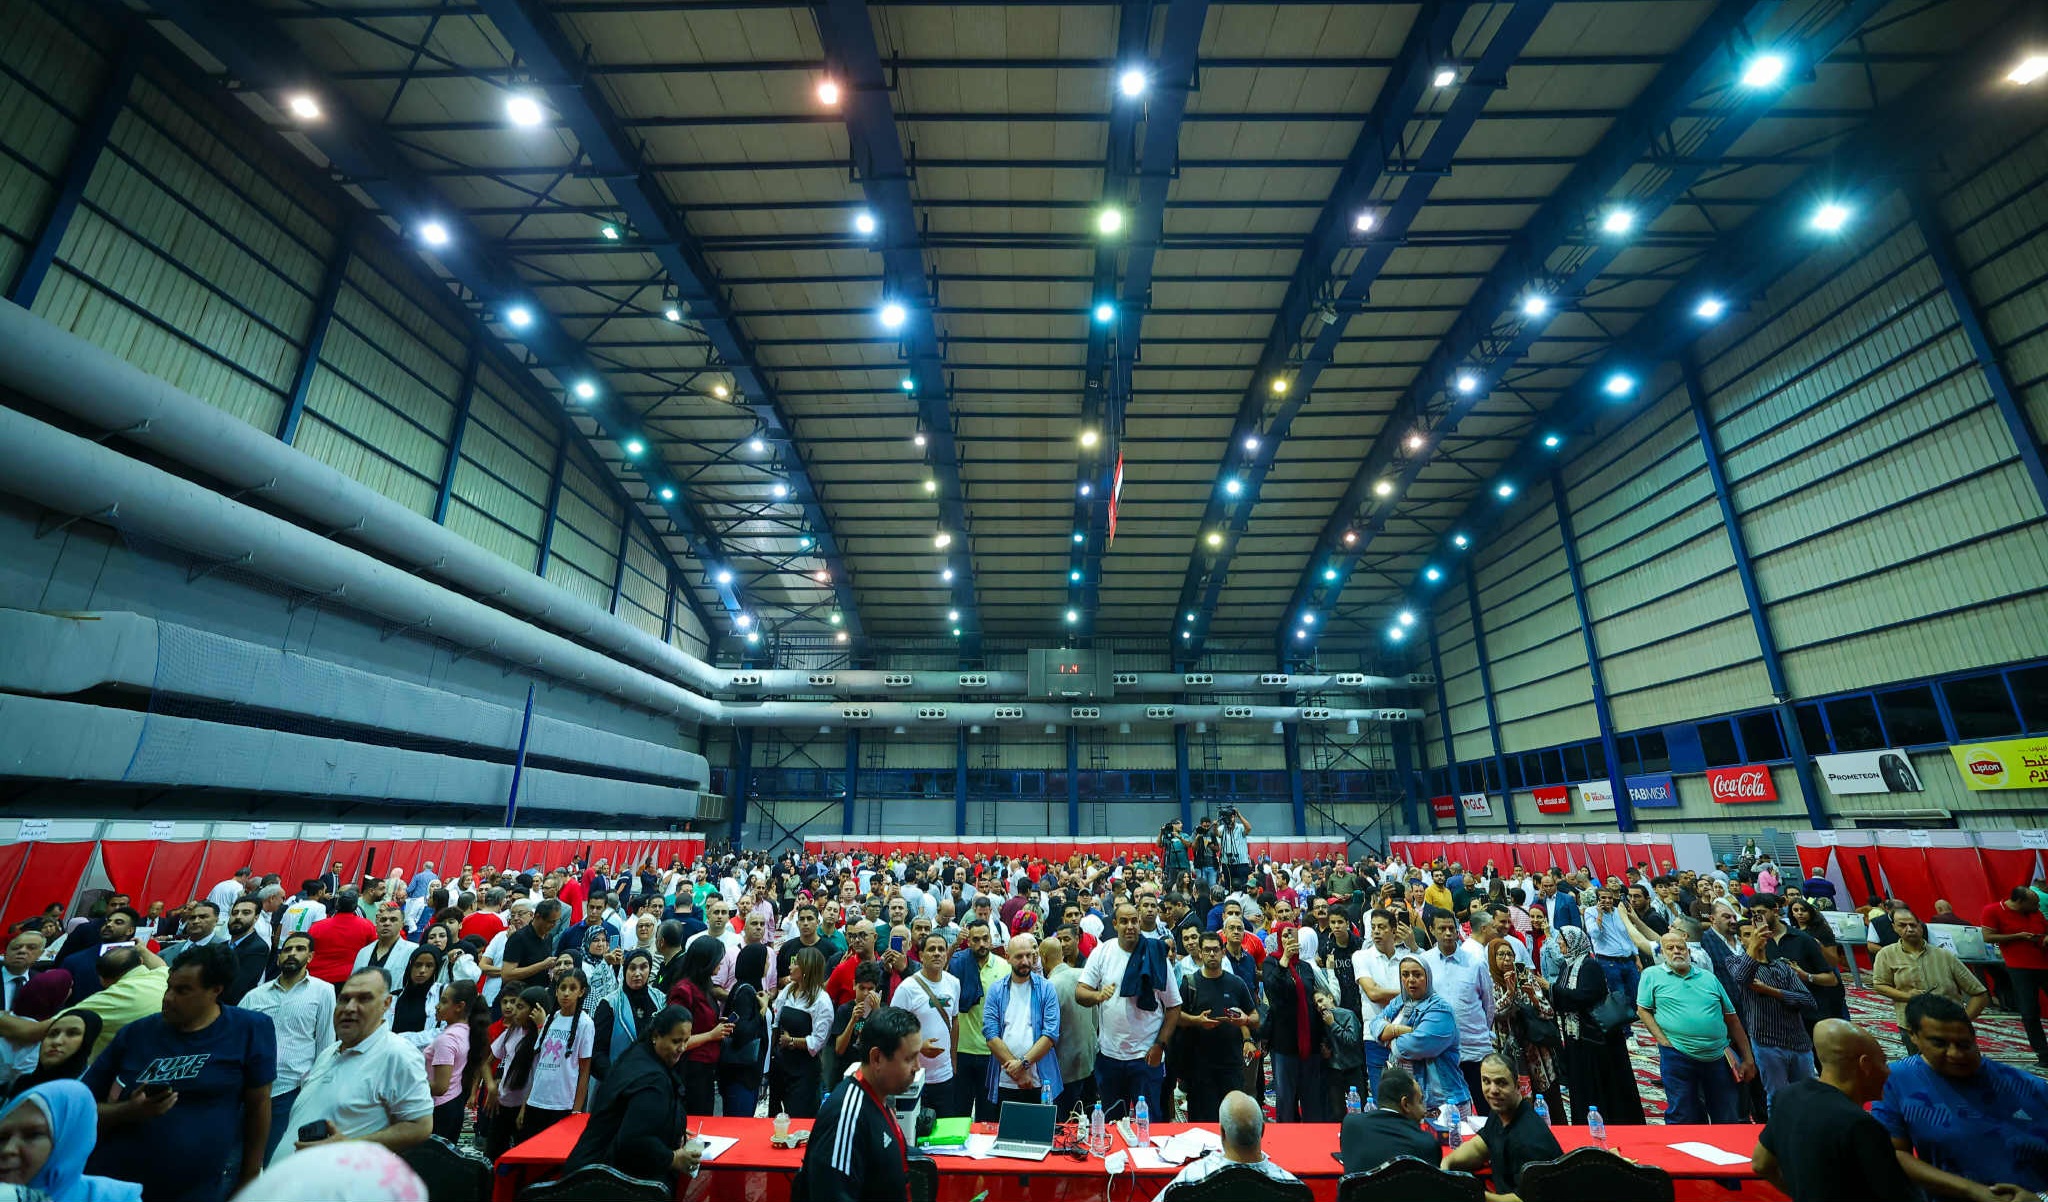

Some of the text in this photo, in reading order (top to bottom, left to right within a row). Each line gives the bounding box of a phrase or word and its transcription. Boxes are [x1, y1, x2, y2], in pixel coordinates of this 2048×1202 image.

[1971, 763, 2000, 774] Lipton
[1828, 772, 1880, 781] PROMETEON
[1469, 797, 1485, 810] GLC
[135, 1053, 211, 1083] NIKE
